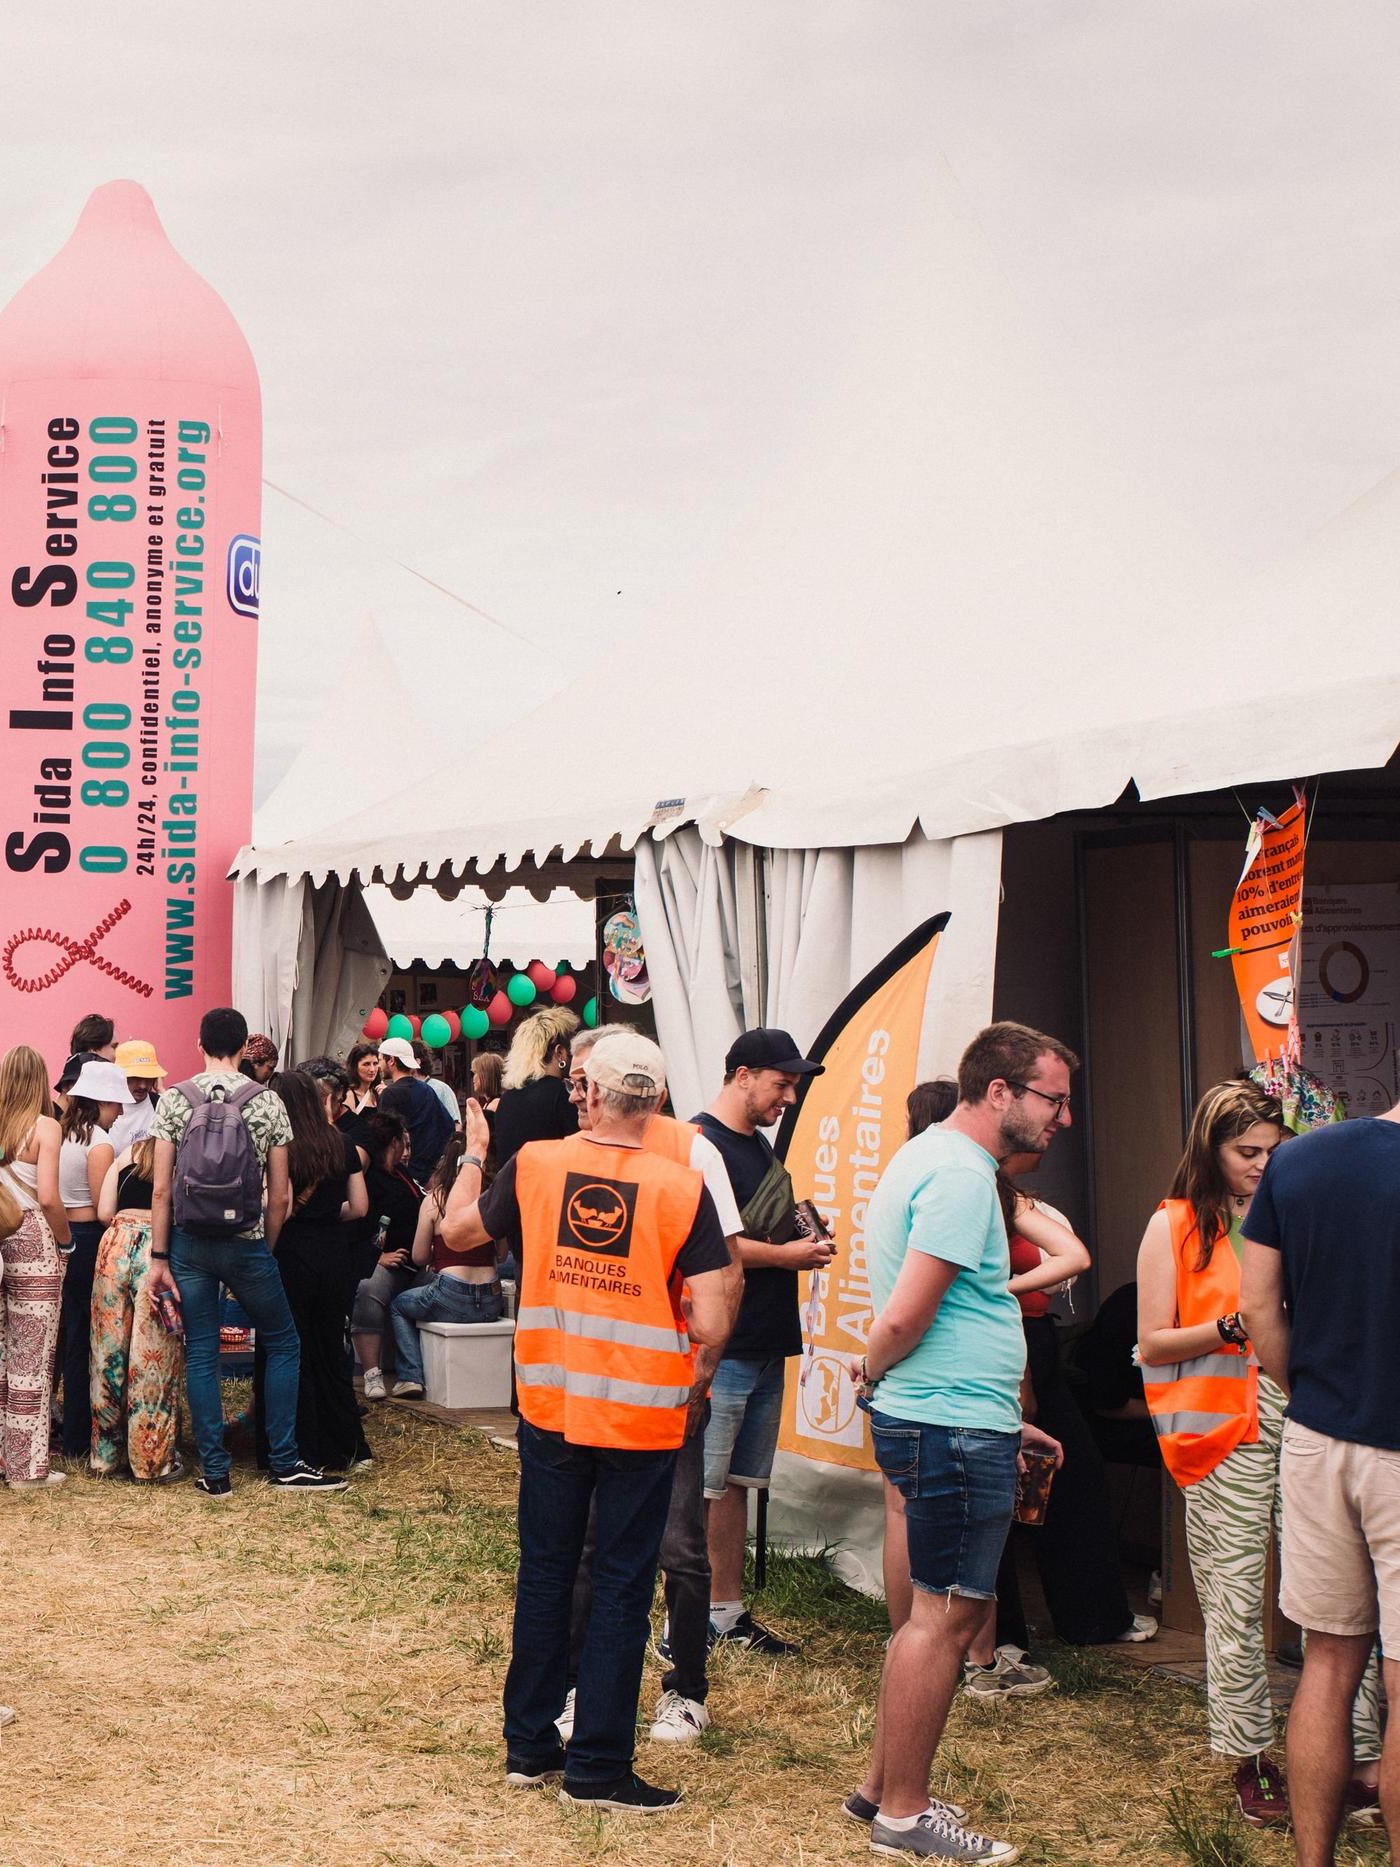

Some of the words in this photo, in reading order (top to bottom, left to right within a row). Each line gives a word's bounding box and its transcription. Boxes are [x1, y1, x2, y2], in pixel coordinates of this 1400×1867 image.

[88, 416, 138, 522] 800
[147, 419, 166, 496] gratuit
[11, 417, 80, 607] Service
[147, 505, 164, 526] et
[85, 561, 135, 664] 840
[146, 535, 164, 633] anonyme
[9, 634, 75, 730] Info
[140, 642, 162, 785] confidentiel,
[161, 420, 211, 1000] www.sida-info-service.org
[81, 703, 131, 807] 800
[5, 758, 72, 873] Sida
[79, 845, 128, 873] 0
[137, 794, 158, 876] 24h/24,
[800, 1115, 841, 1337] Baques
[836, 1028, 891, 1344] Alimentaires
[555, 1254, 627, 1278] BANQUES
